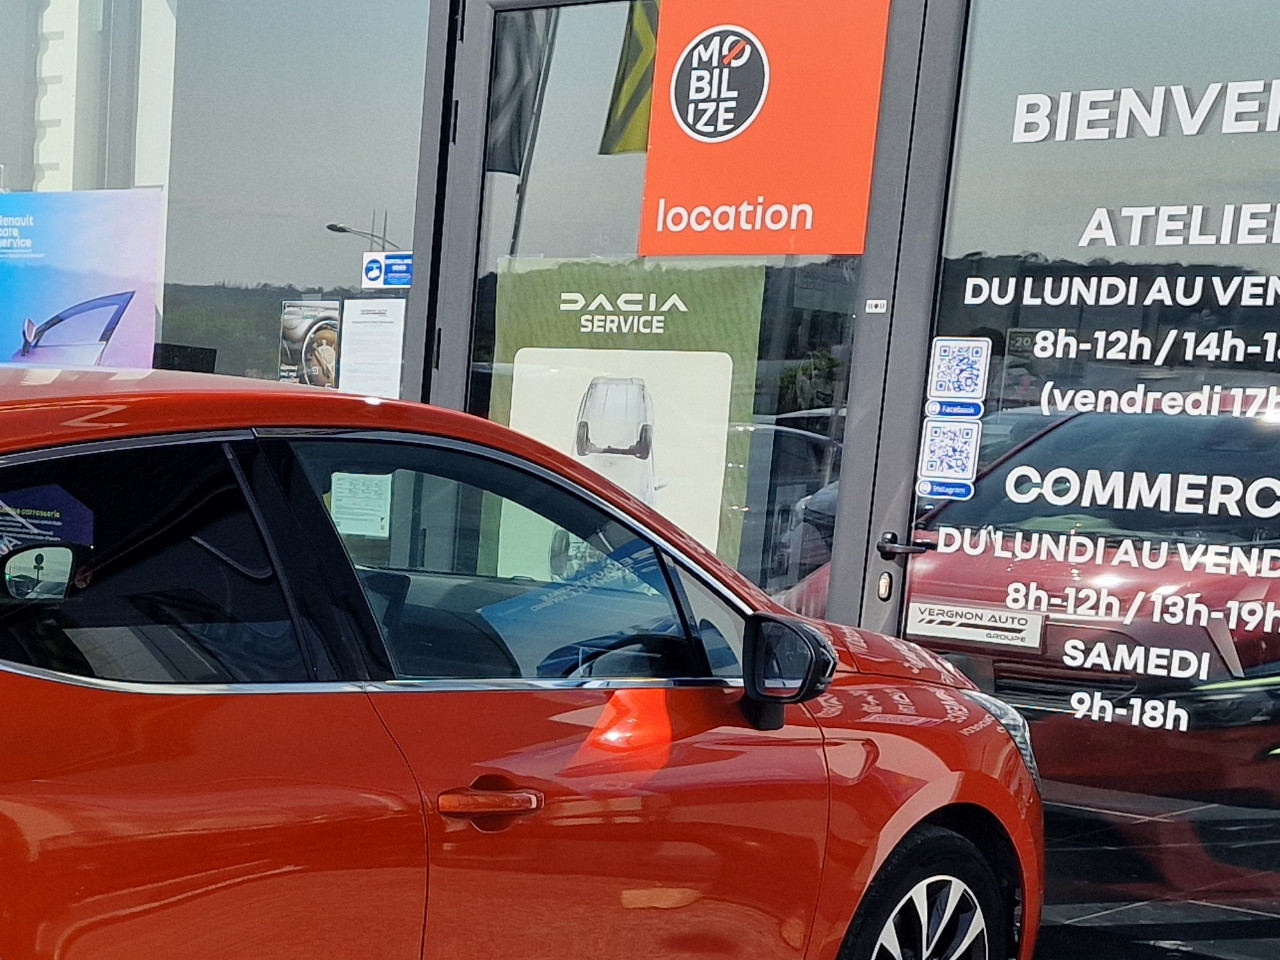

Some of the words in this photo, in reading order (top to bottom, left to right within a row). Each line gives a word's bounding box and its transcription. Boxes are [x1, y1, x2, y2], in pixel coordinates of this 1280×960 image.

[656, 196, 813, 232] location
[559, 292, 689, 312] DACIA
[963, 277, 1016, 305] DU
[1022, 277, 1139, 306] LUNDI
[1143, 276, 1204, 306] AU
[580, 314, 665, 334] SERVICE
[1183, 329, 1280, 363] 14h-1
[1040, 381, 1221, 417] (vendredi
[1005, 465, 1280, 519] COMMERC
[937, 526, 987, 556] DU
[993, 531, 1106, 566] LUNDI
[1111, 539, 1169, 570] AU
[918, 607, 984, 621] VERGNON
[987, 614, 1028, 626] AUTO
[985, 632, 1026, 642] GROUPE
[1062, 639, 1211, 681] SAMEDI
[1070, 691, 1190, 732] 9h-18h
